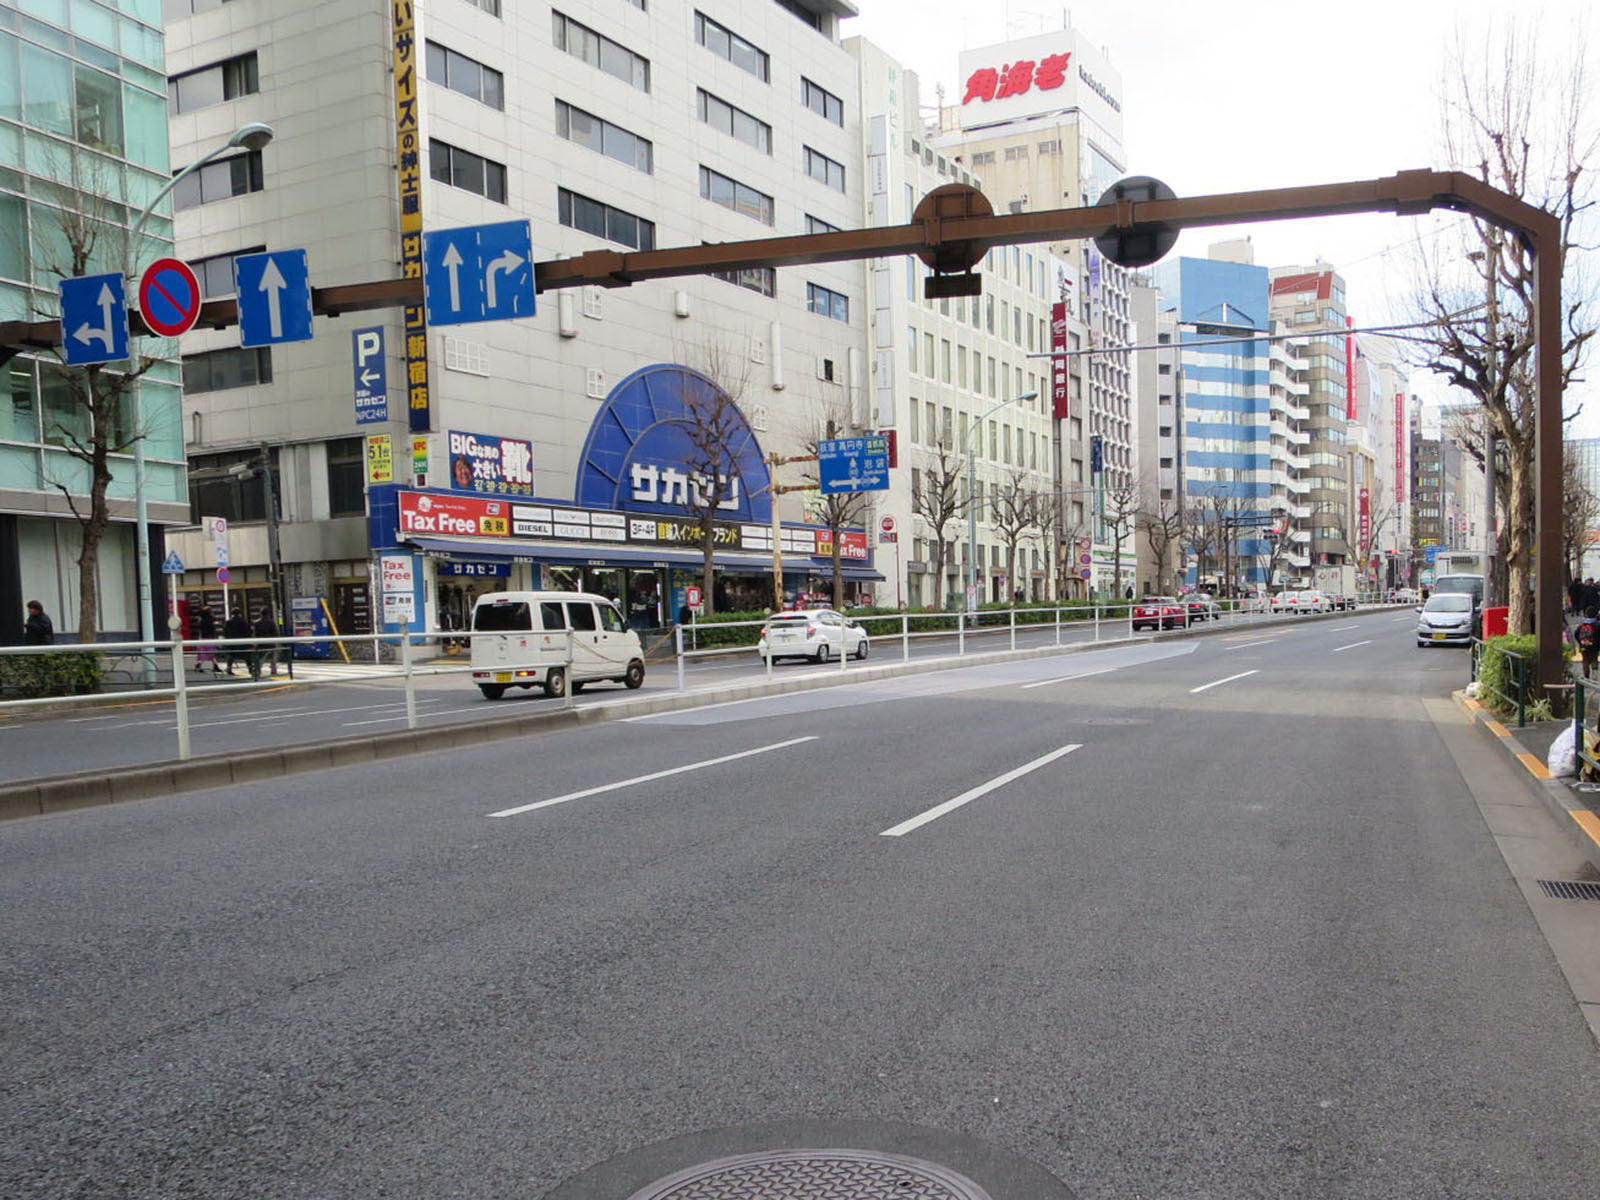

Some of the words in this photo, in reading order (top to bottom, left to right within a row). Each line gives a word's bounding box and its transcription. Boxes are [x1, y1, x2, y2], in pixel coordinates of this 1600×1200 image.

[962, 52, 1072, 105] 角海老
[403, 236, 428, 409] サカン新宿店
[357, 332, 380, 367] P
[501, 440, 531, 483] 靴
[403, 510, 436, 531] Tax
[439, 513, 476, 533] Free
[518, 524, 548, 533] DIESEL
[383, 561, 405, 570] Tax
[384, 571, 410, 580] Free
